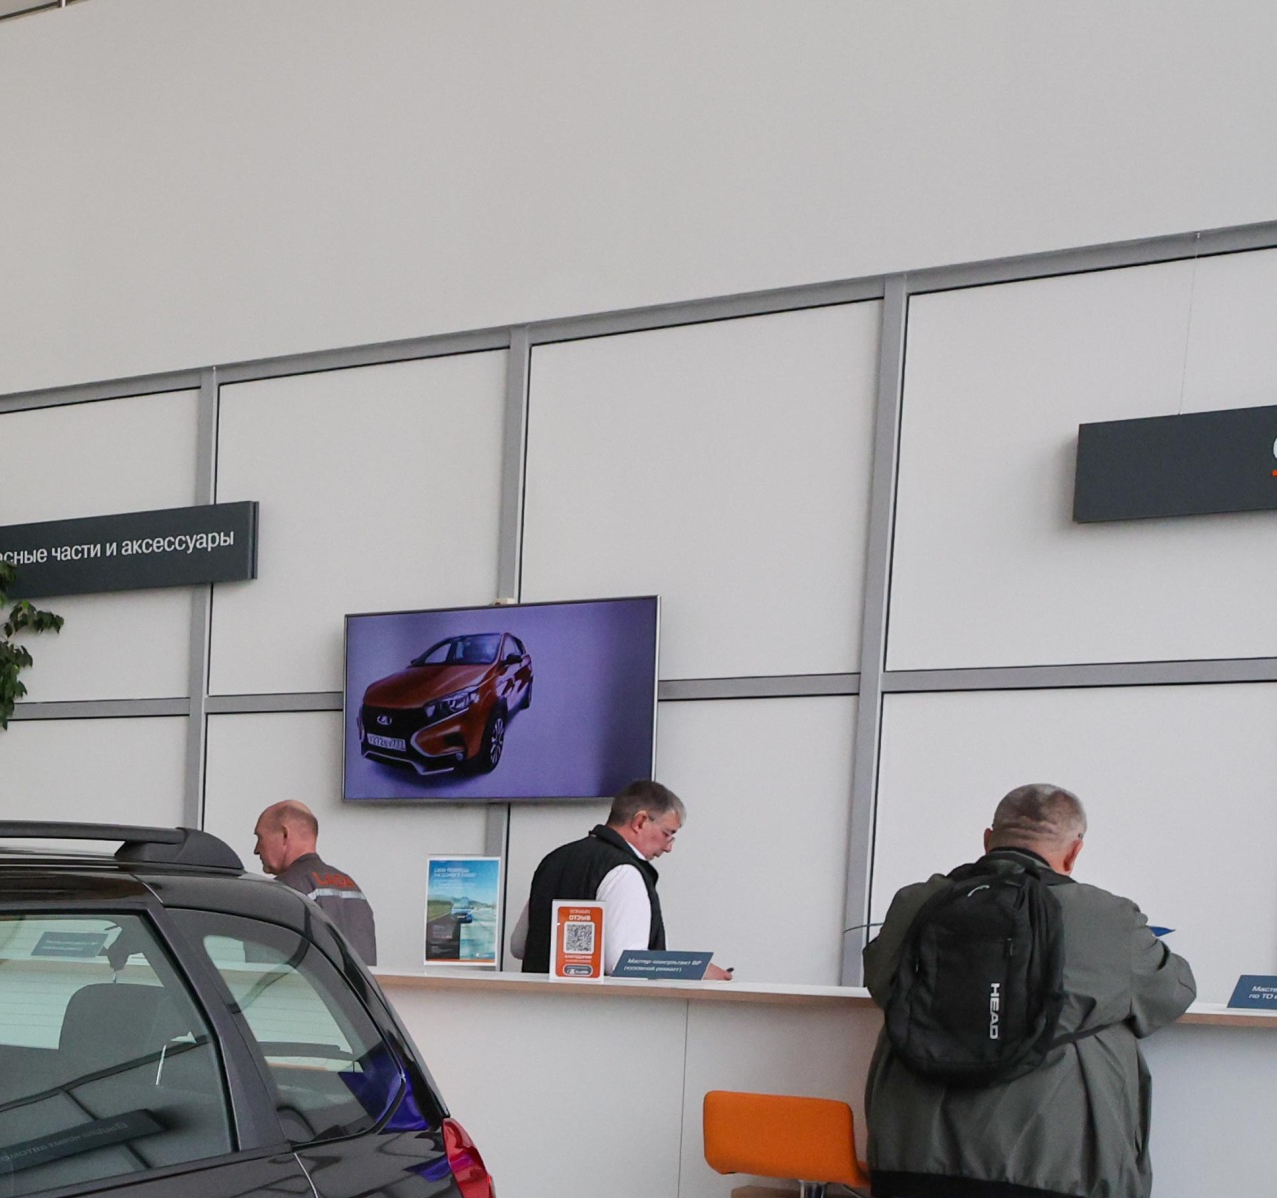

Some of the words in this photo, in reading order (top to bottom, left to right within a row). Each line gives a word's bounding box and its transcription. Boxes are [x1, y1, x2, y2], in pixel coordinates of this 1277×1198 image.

[52, 544, 101, 561] части
[106, 541, 116, 556] и
[121, 530, 234, 554] аксессуары
[990, 983, 1000, 1039] HEAD
